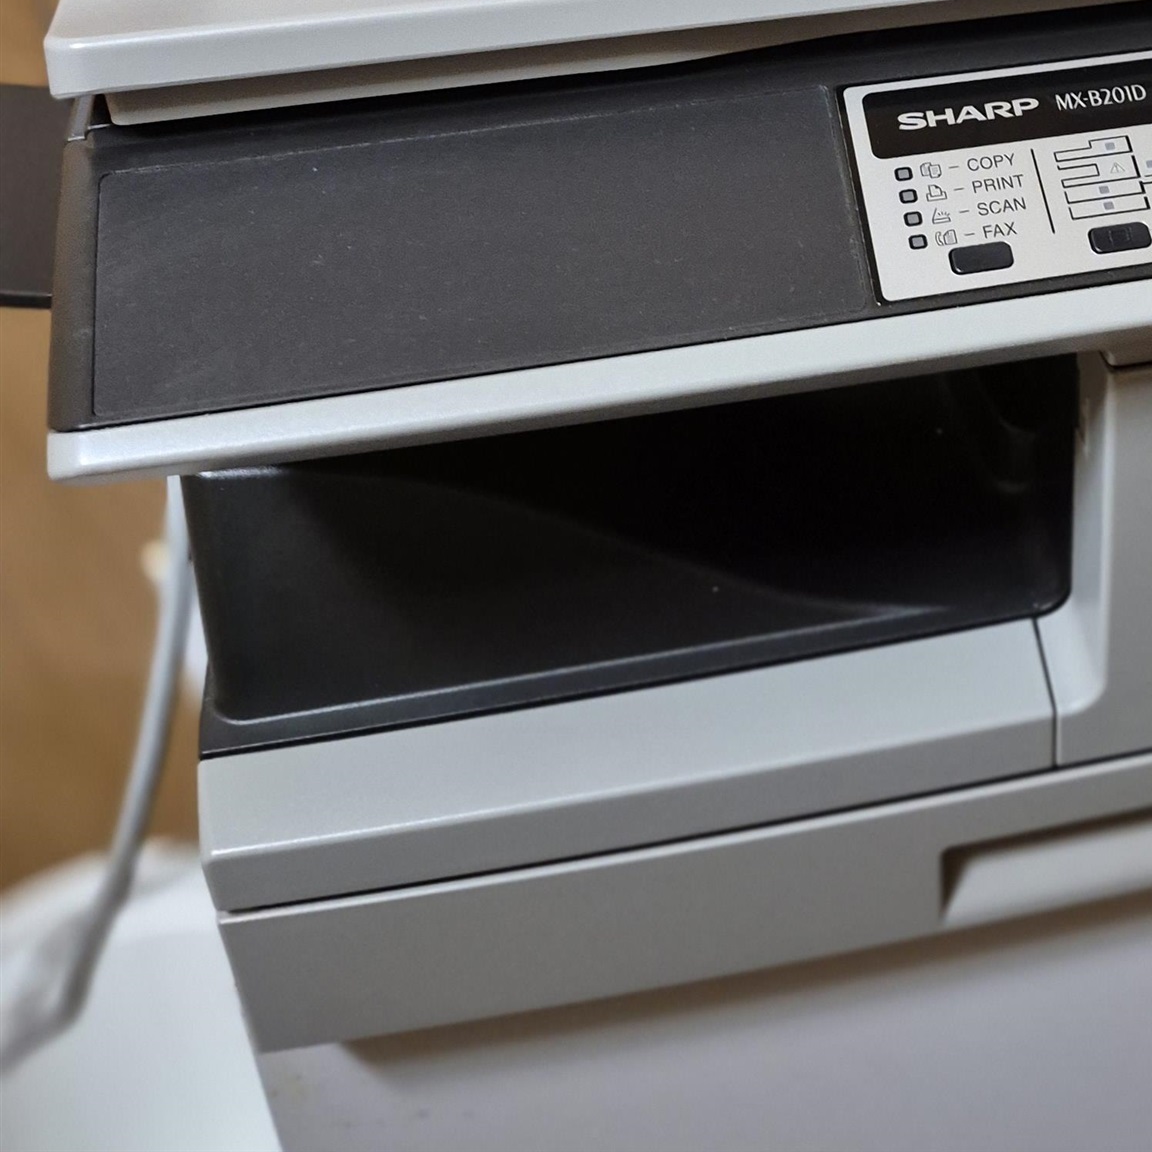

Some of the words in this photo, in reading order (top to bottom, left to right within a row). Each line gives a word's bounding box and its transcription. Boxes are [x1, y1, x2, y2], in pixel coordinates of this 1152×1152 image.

[897, 98, 1040, 130] SHARP
[1055, 84, 1147, 111] MX-B201D
[967, 153, 1016, 172] COPY
[972, 174, 1024, 194] PRINT
[977, 197, 1027, 217] SCAN
[982, 222, 1019, 239] FAX
